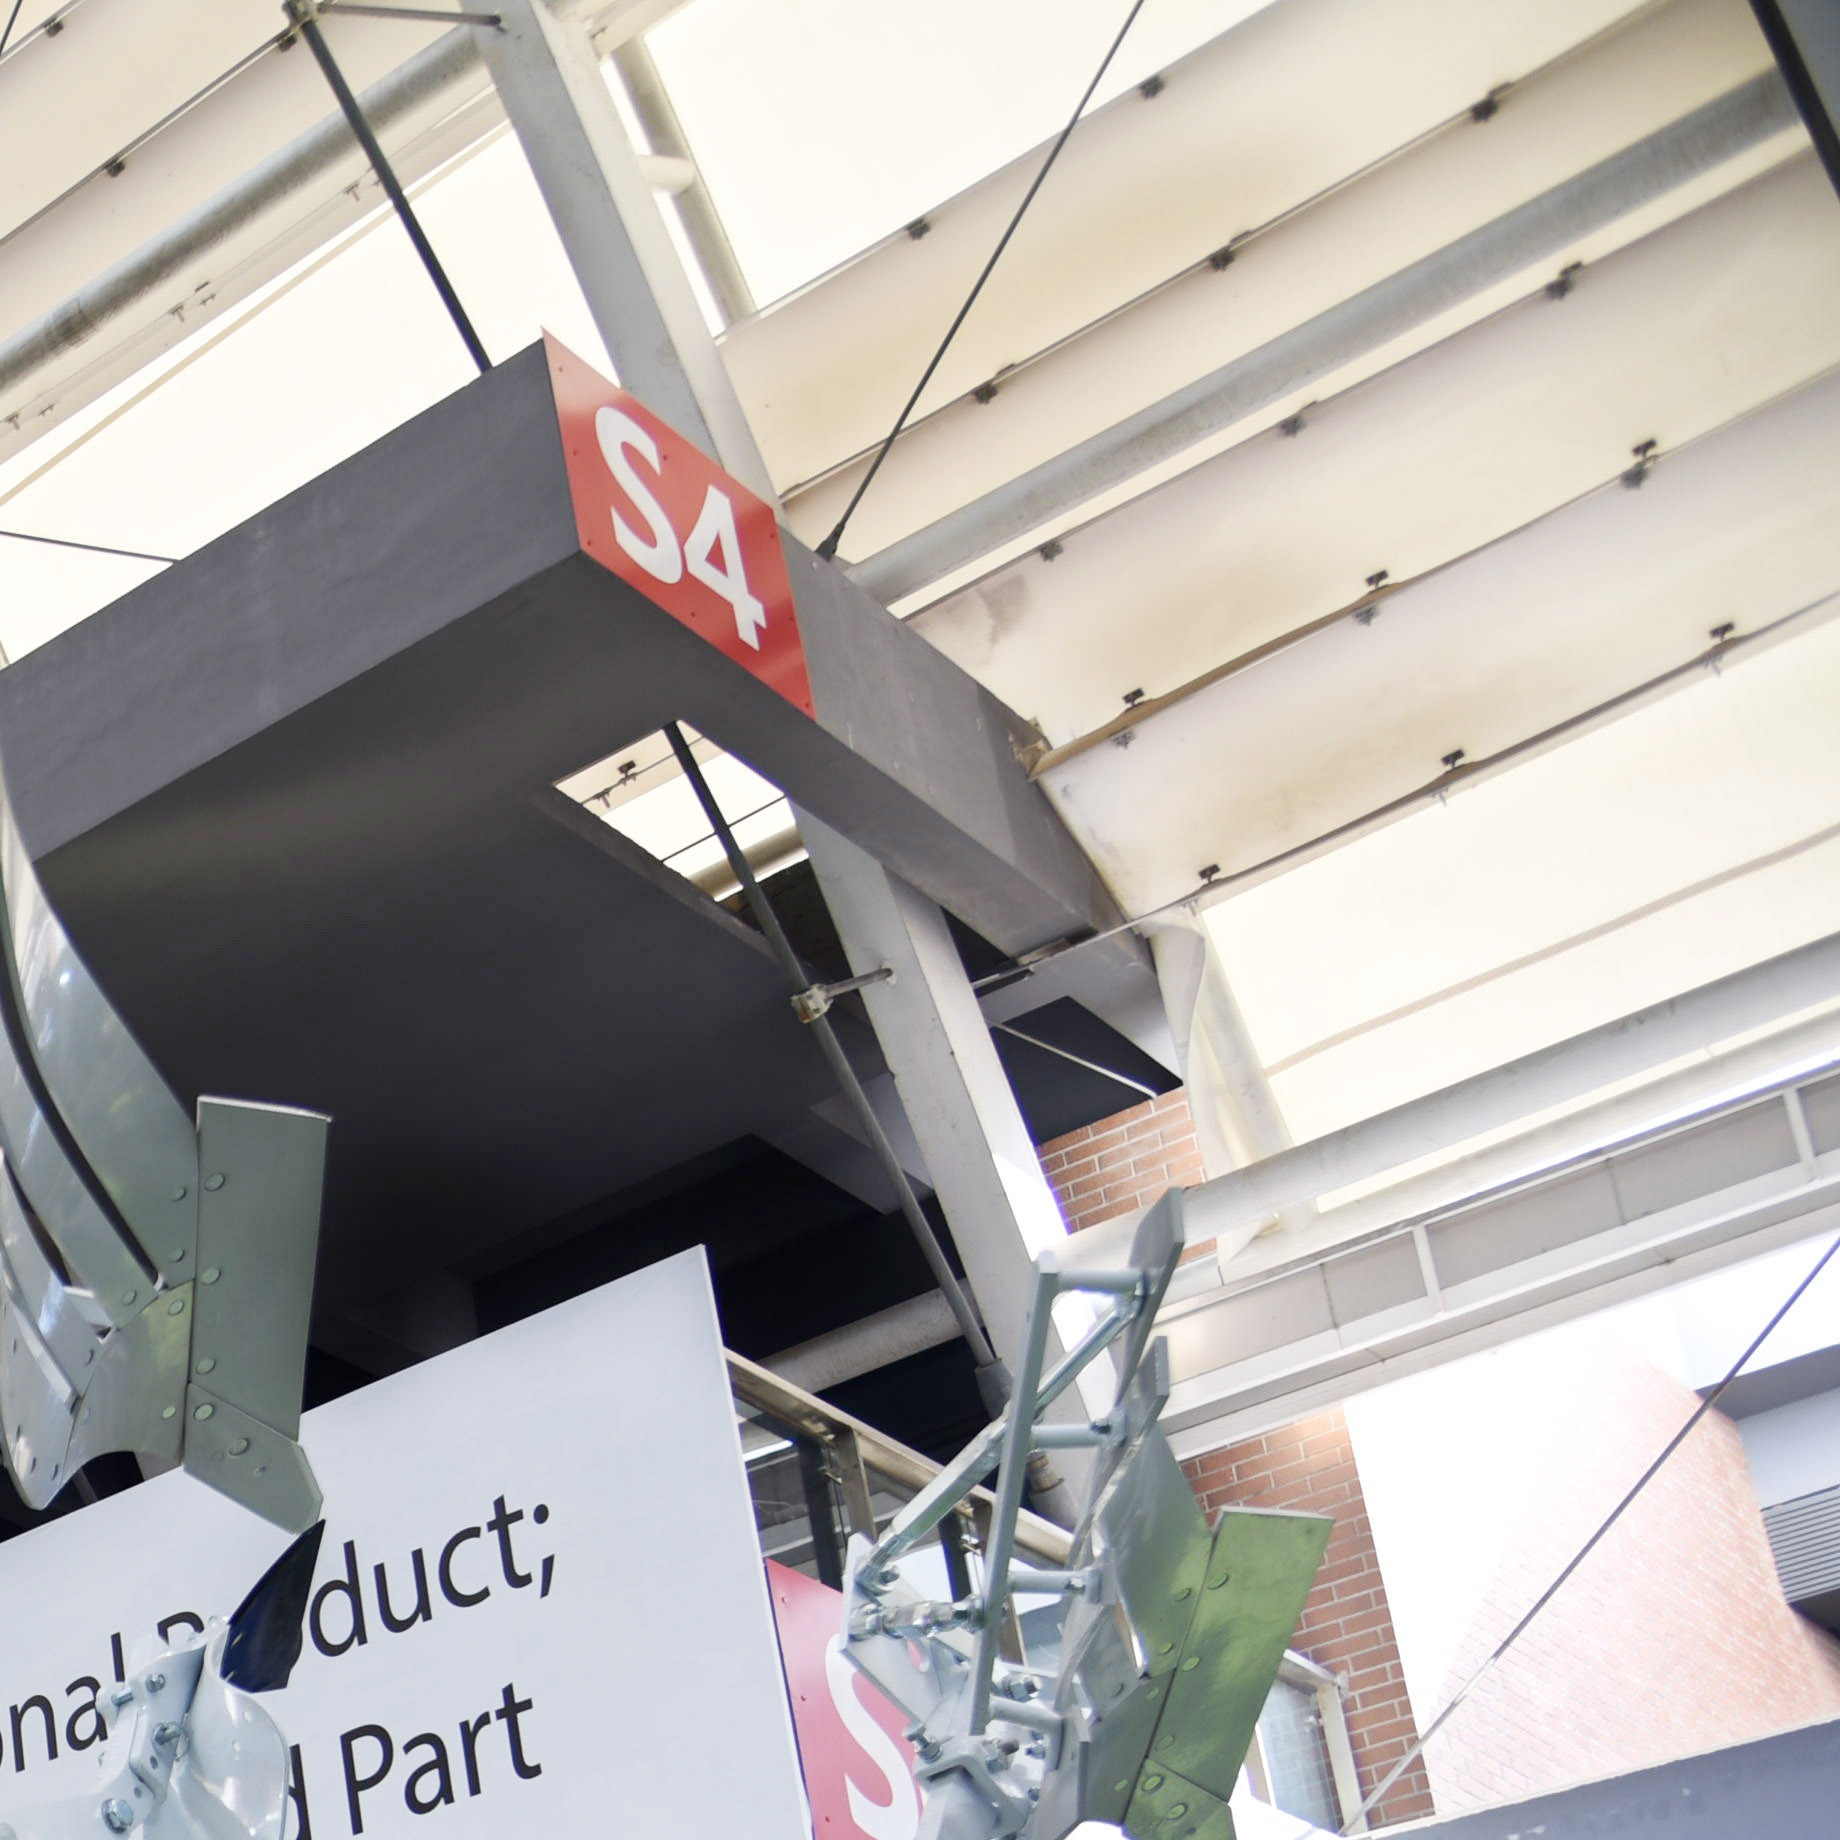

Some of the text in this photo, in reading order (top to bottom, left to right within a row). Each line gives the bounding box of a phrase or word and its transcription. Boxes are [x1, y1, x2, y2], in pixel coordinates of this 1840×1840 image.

[595, 406, 767, 651] S4
[158, 1495, 555, 1670] duct;
[340, 1682, 542, 1836] Part
